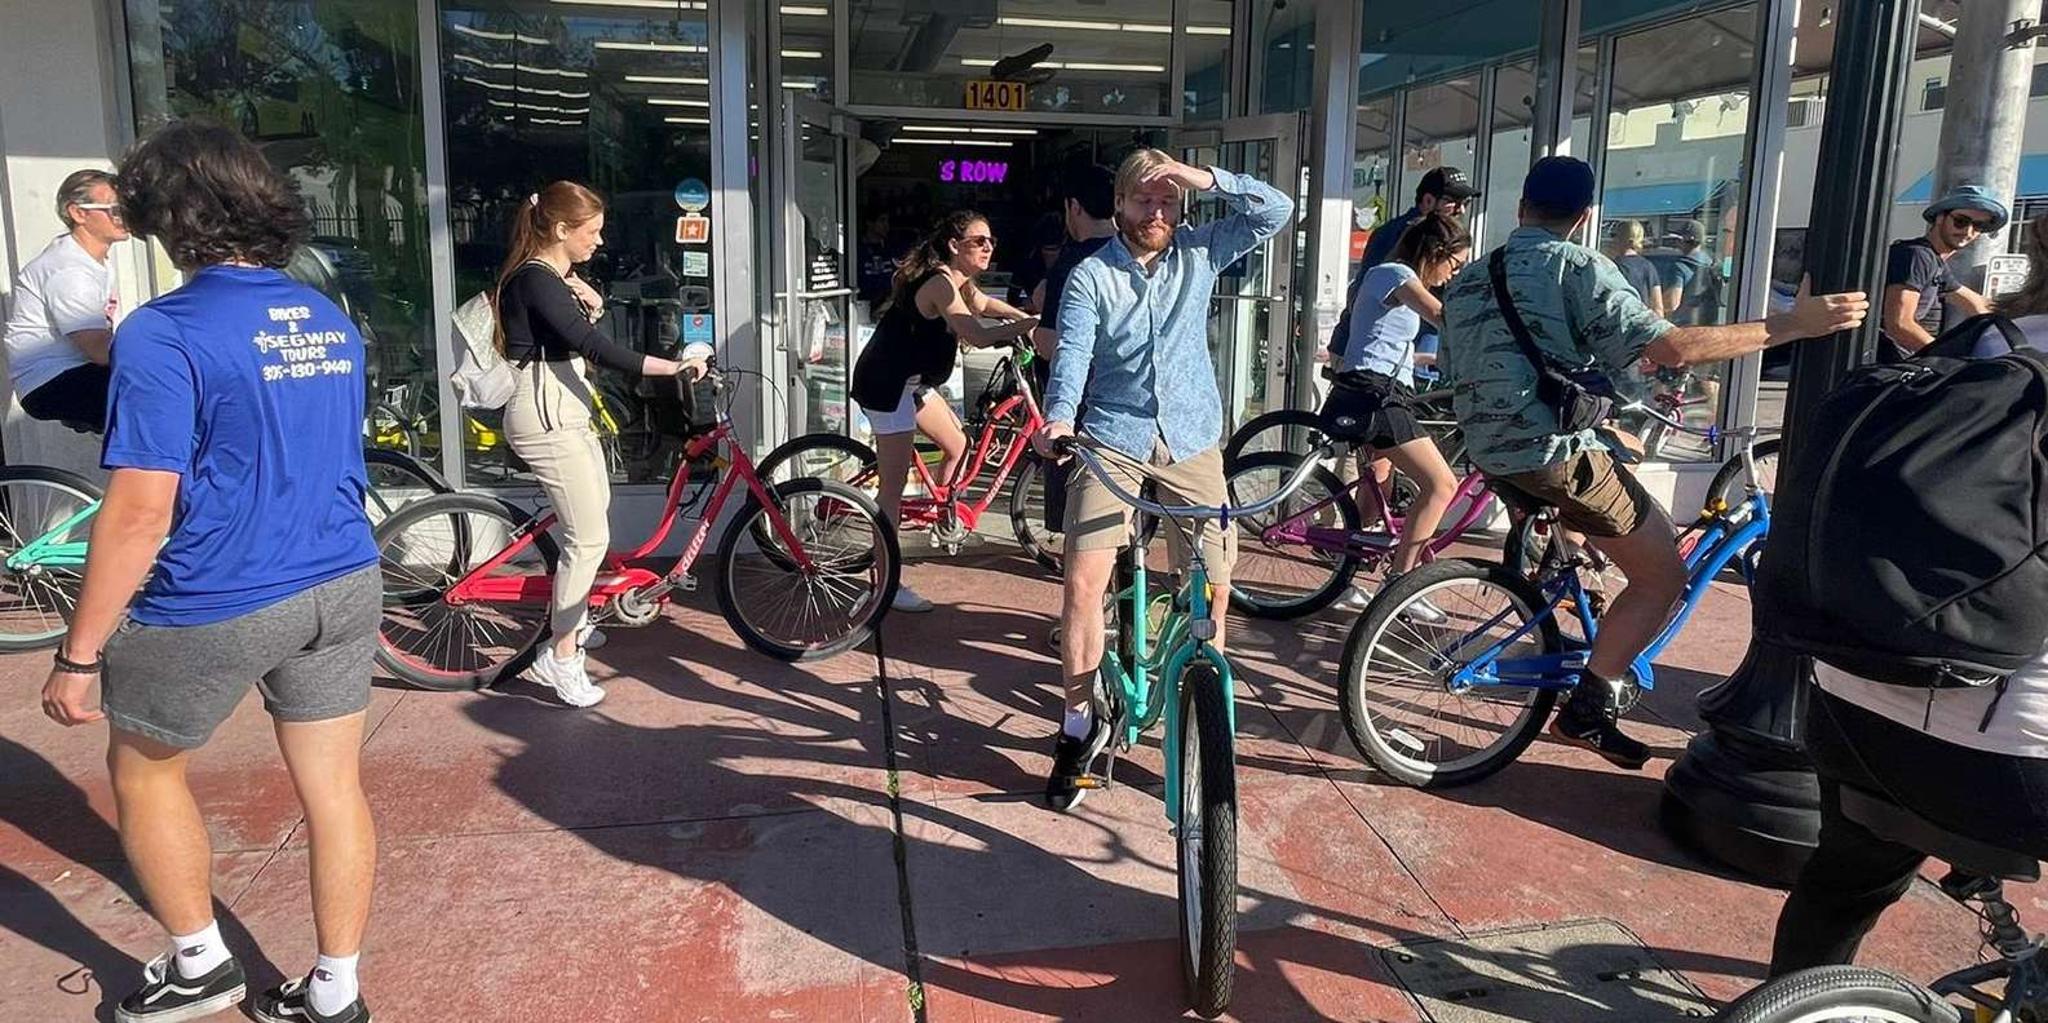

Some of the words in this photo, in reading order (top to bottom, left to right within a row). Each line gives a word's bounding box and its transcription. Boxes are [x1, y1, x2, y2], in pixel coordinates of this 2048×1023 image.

[970, 82, 1023, 109] 1401
[961, 160, 1008, 183] ROW
[268, 306, 311, 321] BIKES
[267, 331, 346, 349] SEGWAY
[280, 346, 327, 362] TOURS
